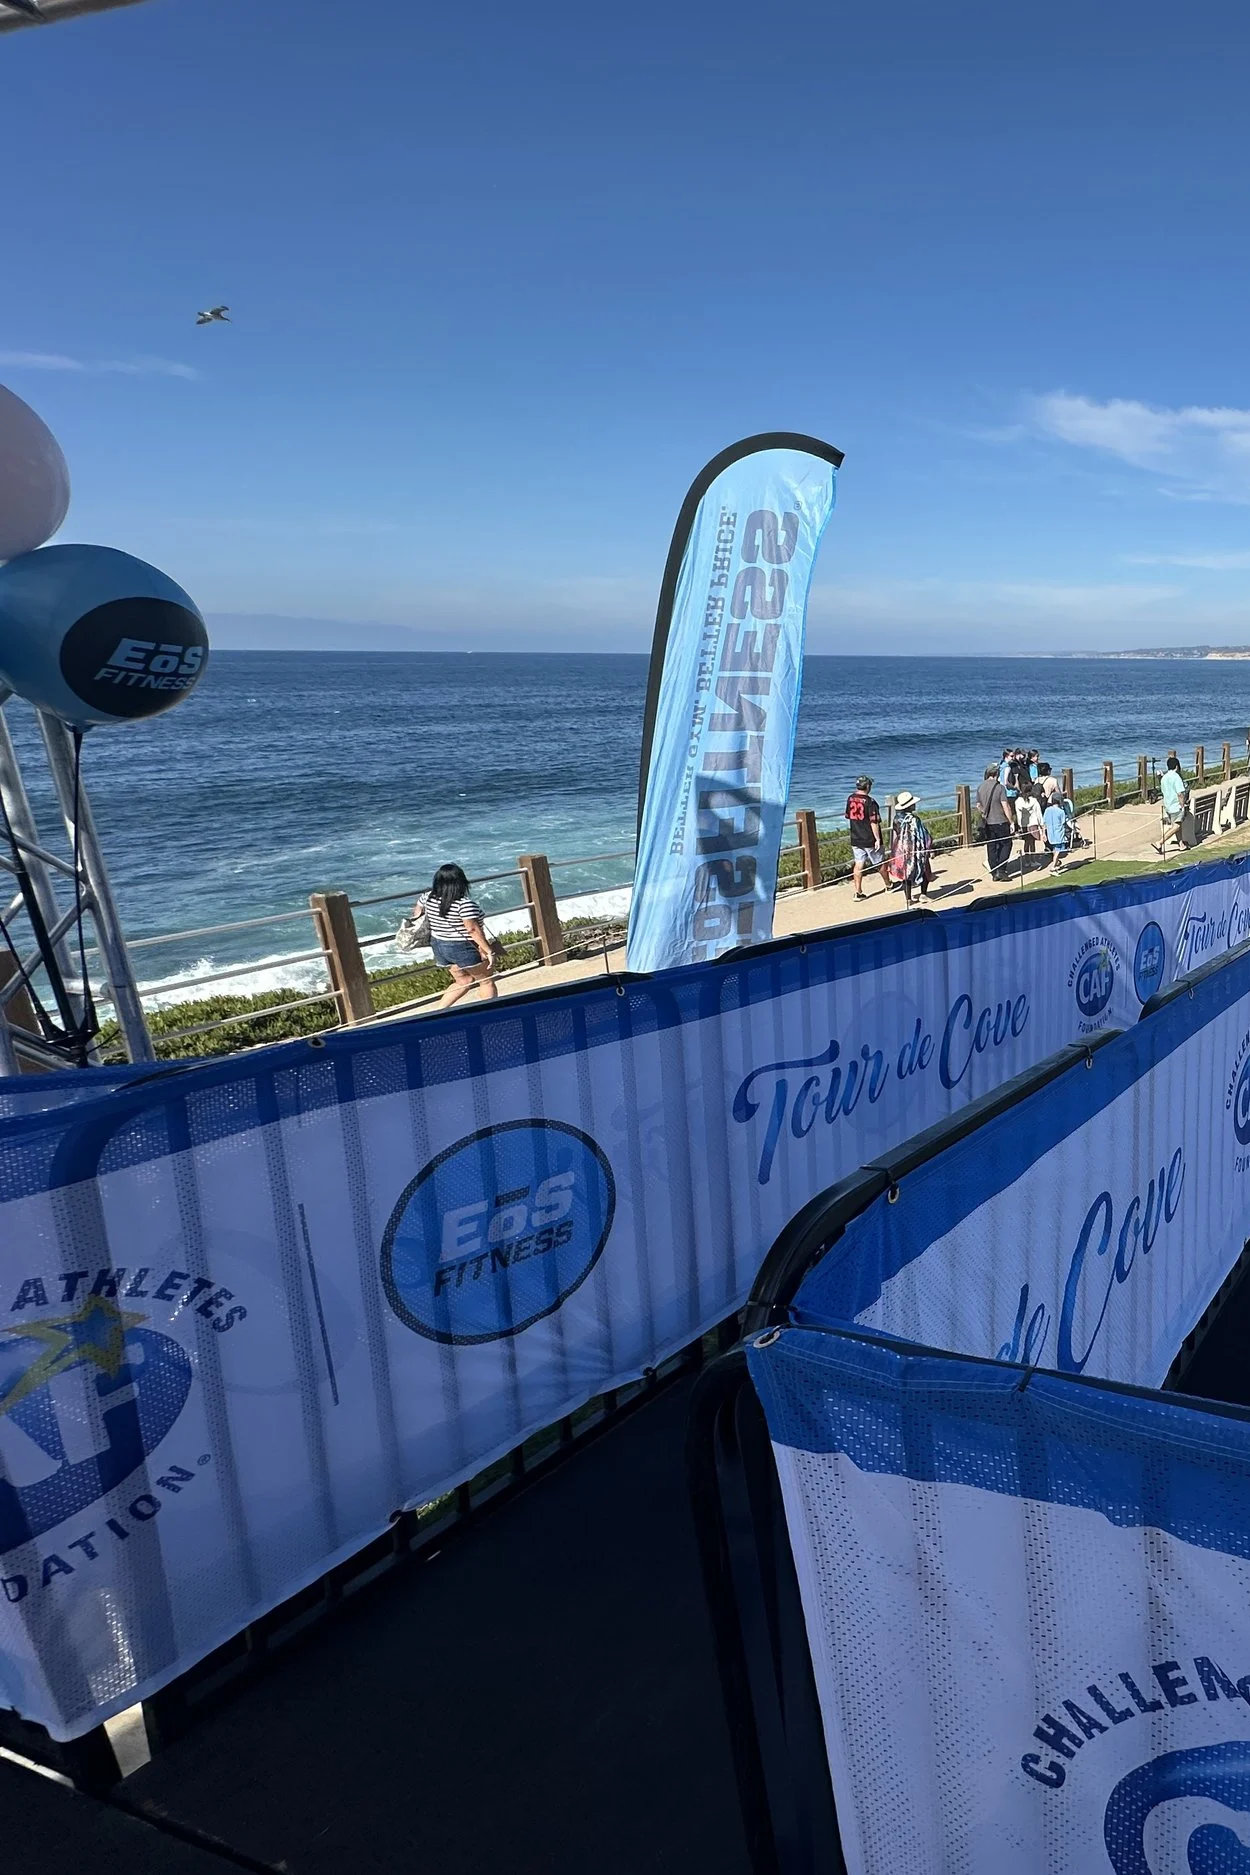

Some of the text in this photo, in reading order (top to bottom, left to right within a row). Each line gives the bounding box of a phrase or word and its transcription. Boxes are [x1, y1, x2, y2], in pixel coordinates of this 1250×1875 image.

[94, 667, 197, 690] FITNESS
[850, 801, 865, 820] 23
[1067, 936, 1100, 988] CHALLENGED
[1184, 911, 1216, 971] Tour
[1079, 968, 1110, 1005] CAF
[733, 993, 1031, 1186] Tour de Cove
[432, 1219, 574, 1299] FITNESS
[996, 1147, 1187, 1374] de Cove
[10, 1266, 249, 1334] ATHLETES
